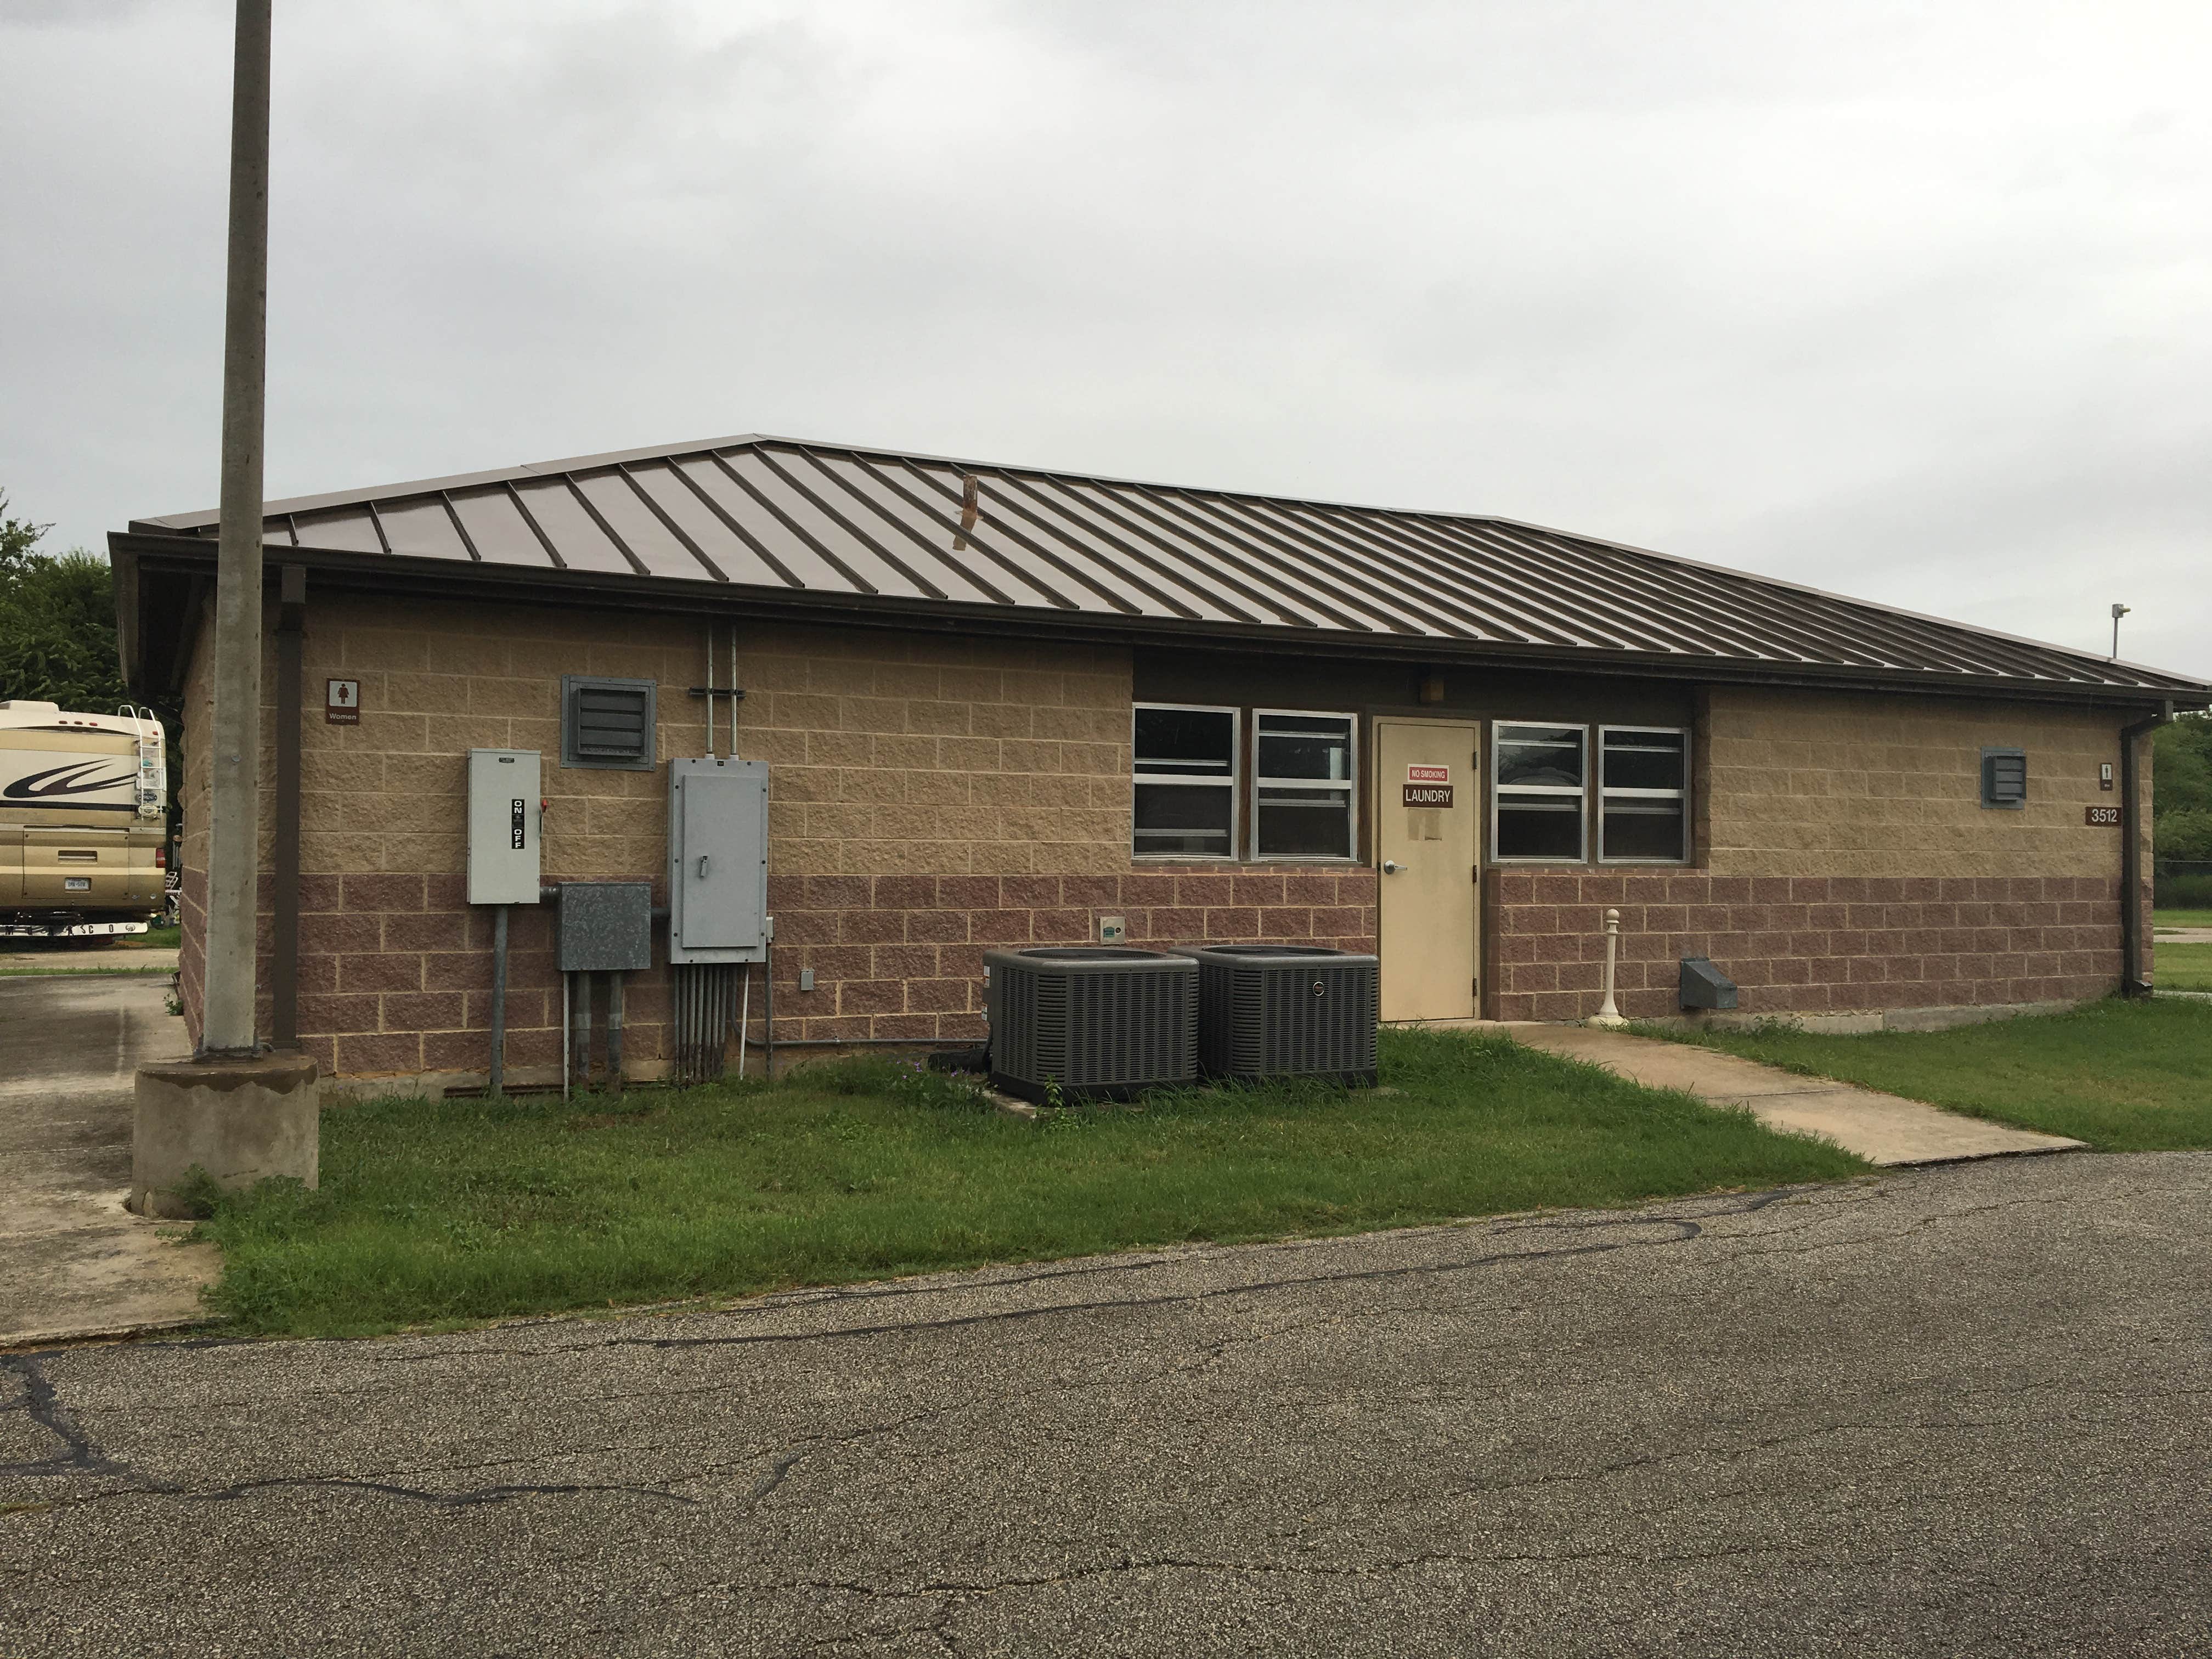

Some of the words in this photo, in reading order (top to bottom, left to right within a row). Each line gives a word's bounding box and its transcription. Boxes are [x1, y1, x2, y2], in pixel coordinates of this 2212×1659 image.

[1421, 770, 1445, 778] SMOKING
[1406, 789, 1451, 802] LAUNDRY
[514, 800, 522, 814] ON
[2091, 809, 2118, 822] 3512
[514, 829, 522, 848] OFF
